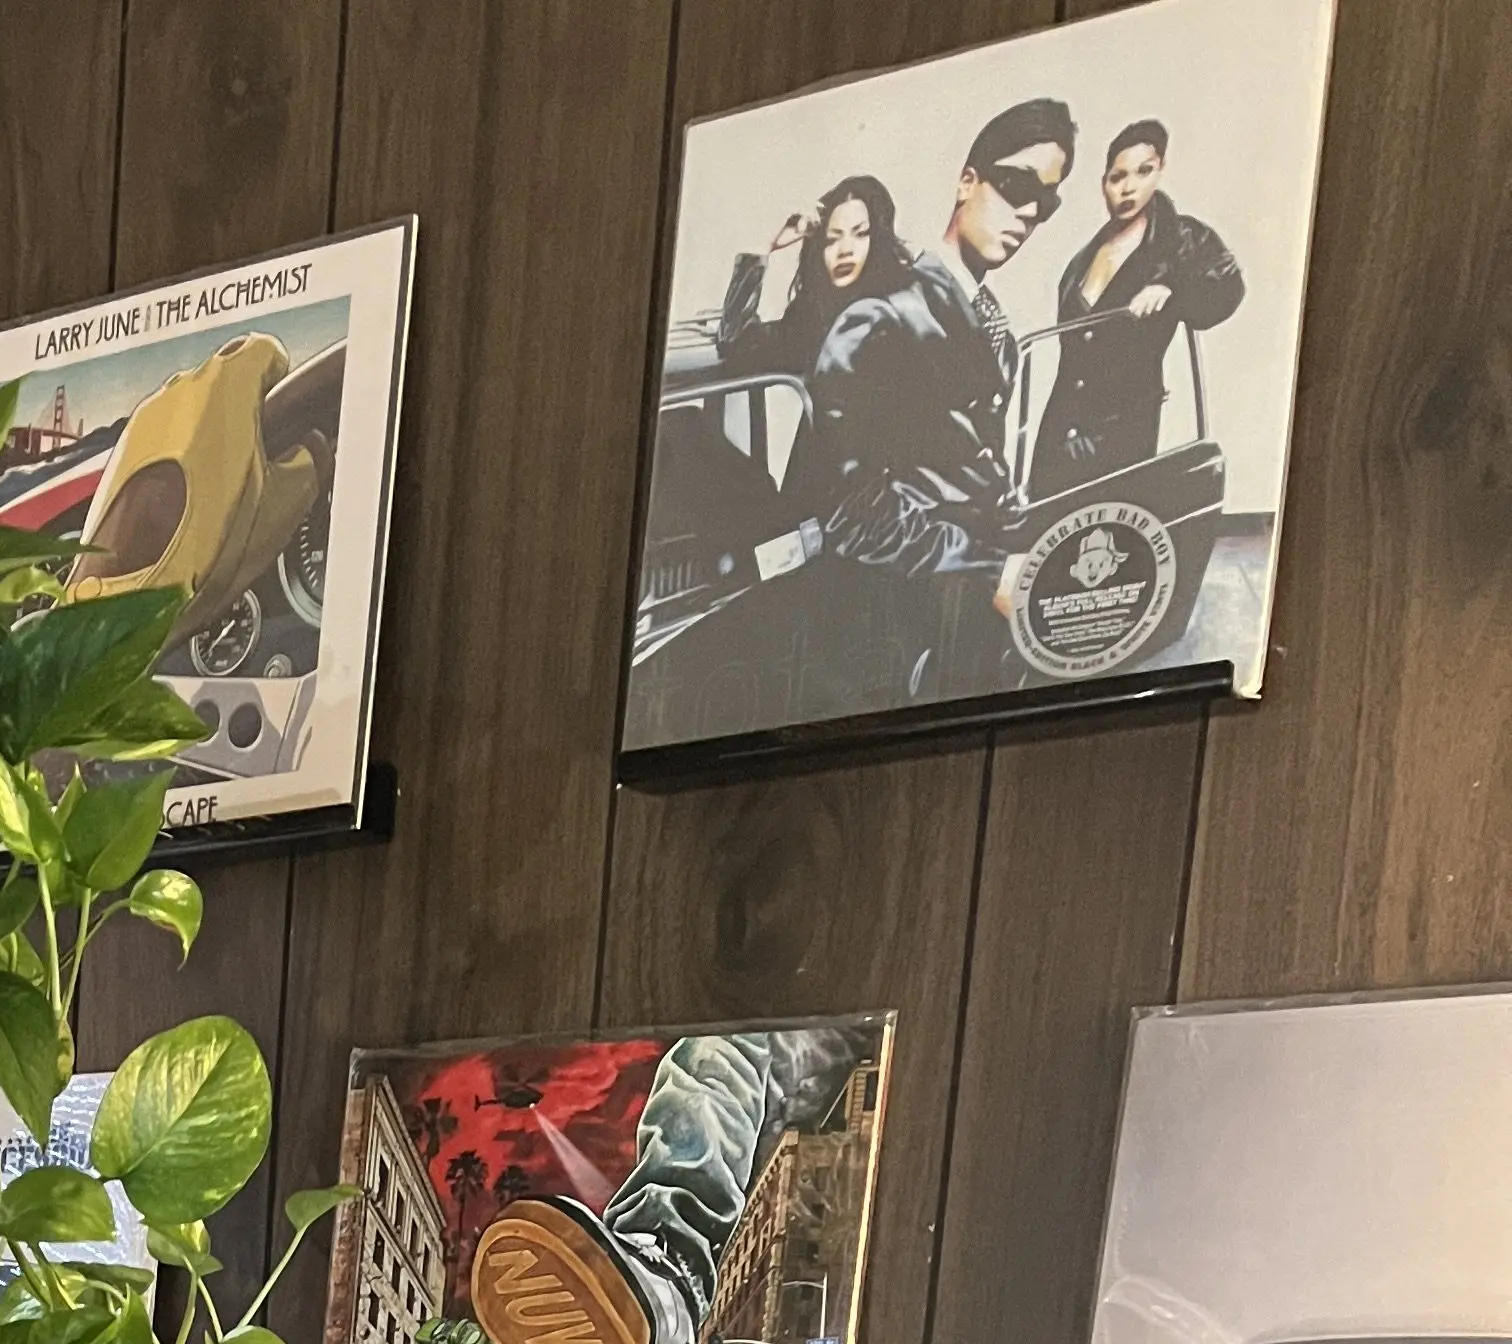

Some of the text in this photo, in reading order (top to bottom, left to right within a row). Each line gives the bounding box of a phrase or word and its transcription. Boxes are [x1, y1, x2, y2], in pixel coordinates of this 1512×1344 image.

[34, 263, 314, 360] LARRY JUNE THE ALCHEMIST
[1019, 507, 1172, 591] CELEBRATE BAD BOY
[160, 795, 220, 830] CAPE
